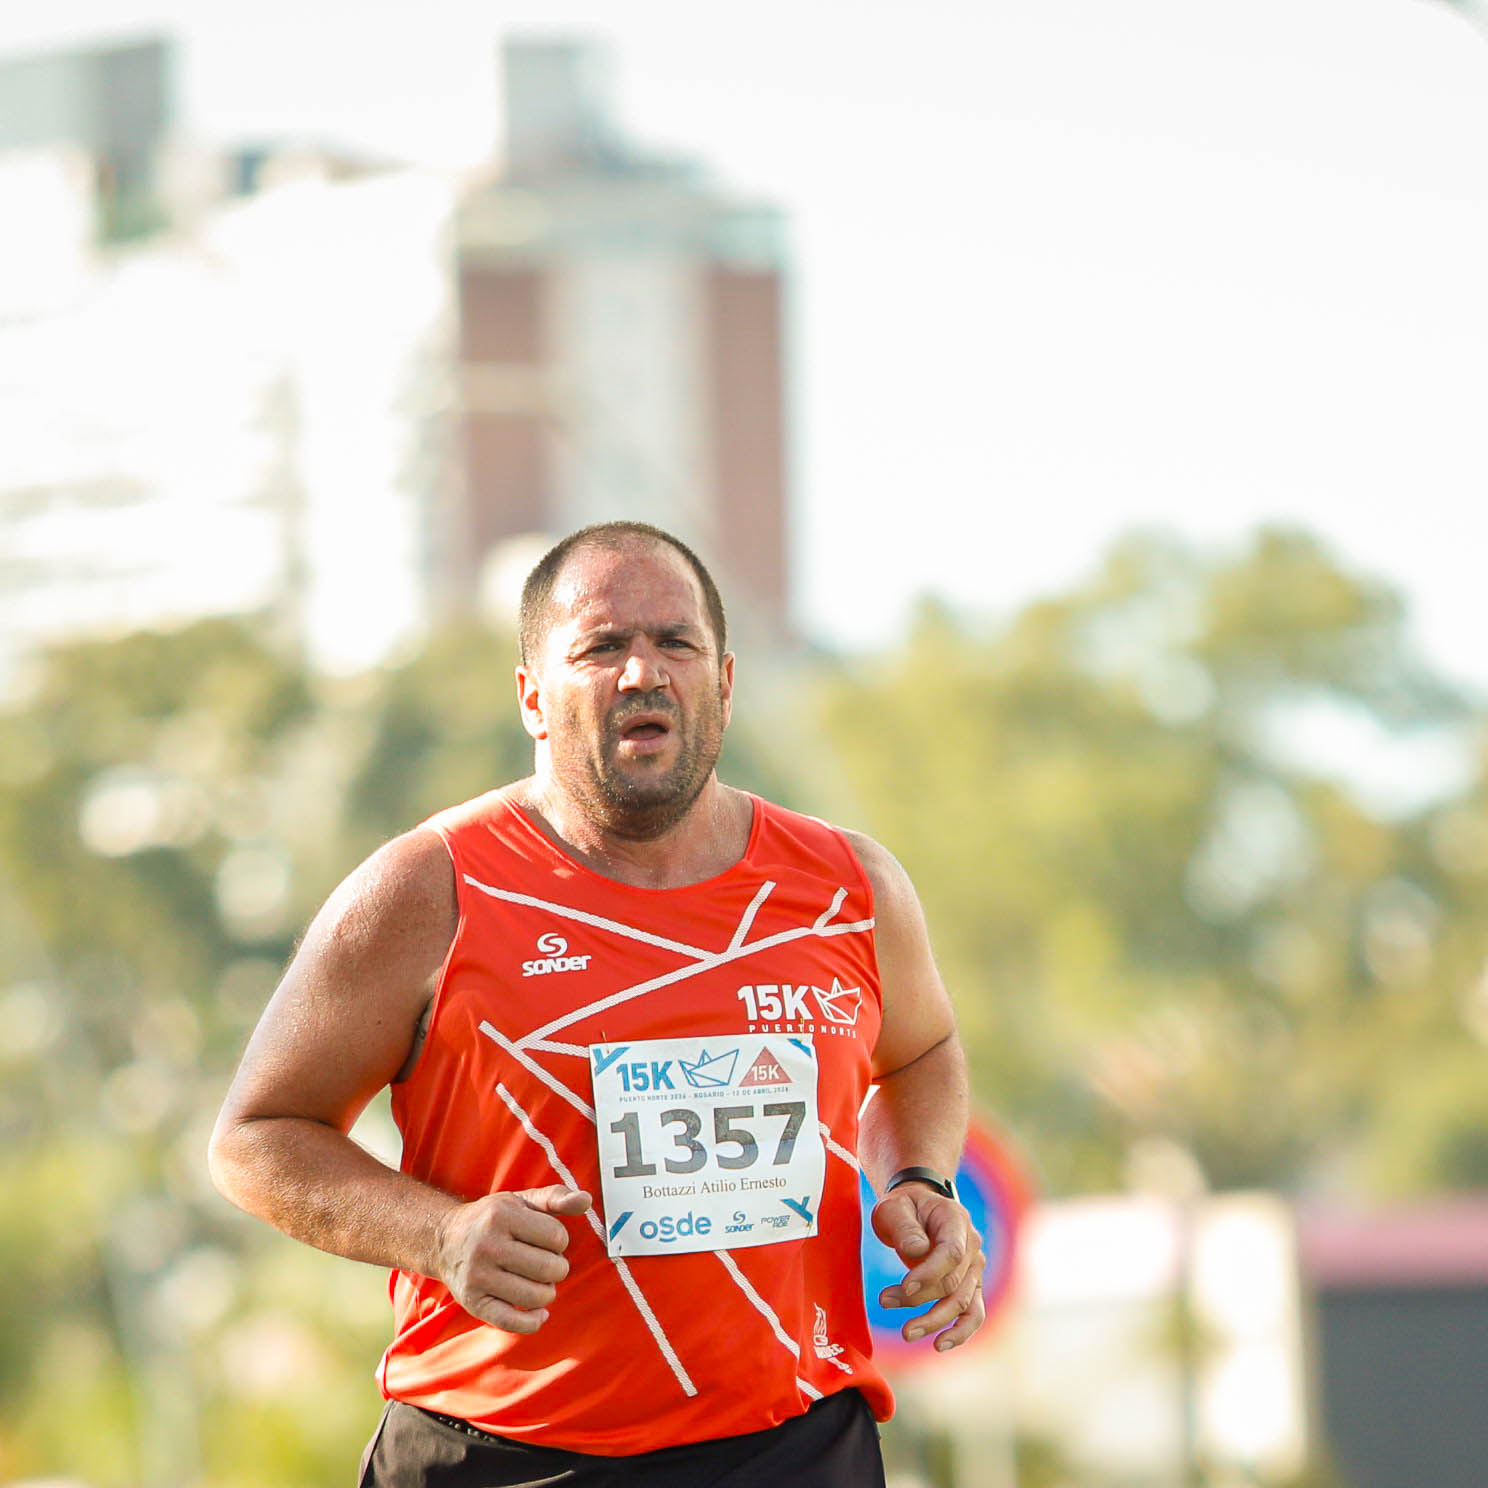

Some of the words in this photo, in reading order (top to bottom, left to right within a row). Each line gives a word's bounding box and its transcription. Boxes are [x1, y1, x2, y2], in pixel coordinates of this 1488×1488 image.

[737, 984, 814, 1021] 15K
[748, 1023, 815, 1033] PUERTO
[820, 1025, 857, 1039] NORTE
[615, 1060, 676, 1092] 15K
[751, 1063, 781, 1081] 15K
[694, 1090, 725, 1099] ROSARIO
[610, 1101, 806, 1179] 1357
[643, 1181, 696, 1199] Bottazzi
[700, 1179, 737, 1195] Atilio
[740, 1177, 787, 1191] Ernesto
[639, 1211, 712, 1241] osde
